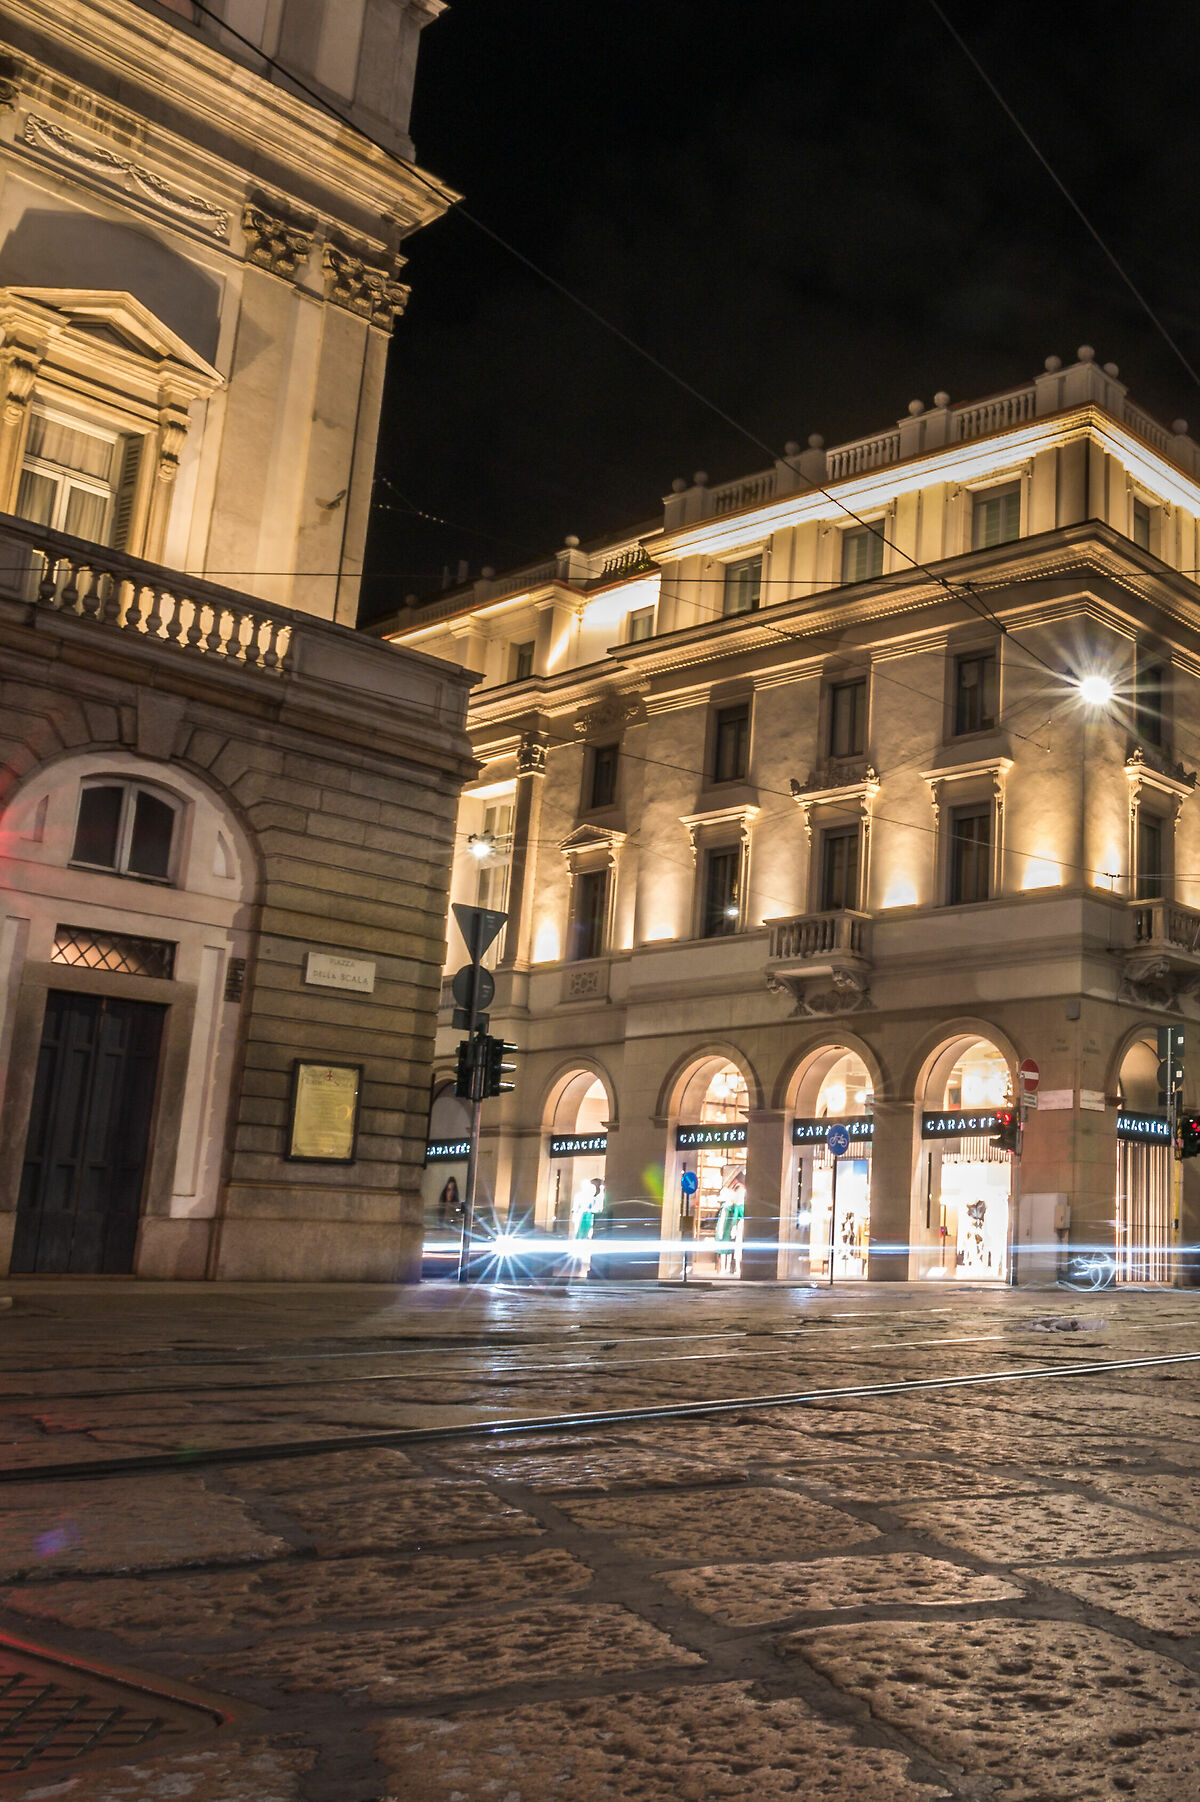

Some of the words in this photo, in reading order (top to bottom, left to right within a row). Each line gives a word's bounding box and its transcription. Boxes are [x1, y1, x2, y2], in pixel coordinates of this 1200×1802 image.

[329, 957, 355, 968] PIAZZA
[313, 968, 337, 980] DELLA
[340, 972, 370, 985] SCALA
